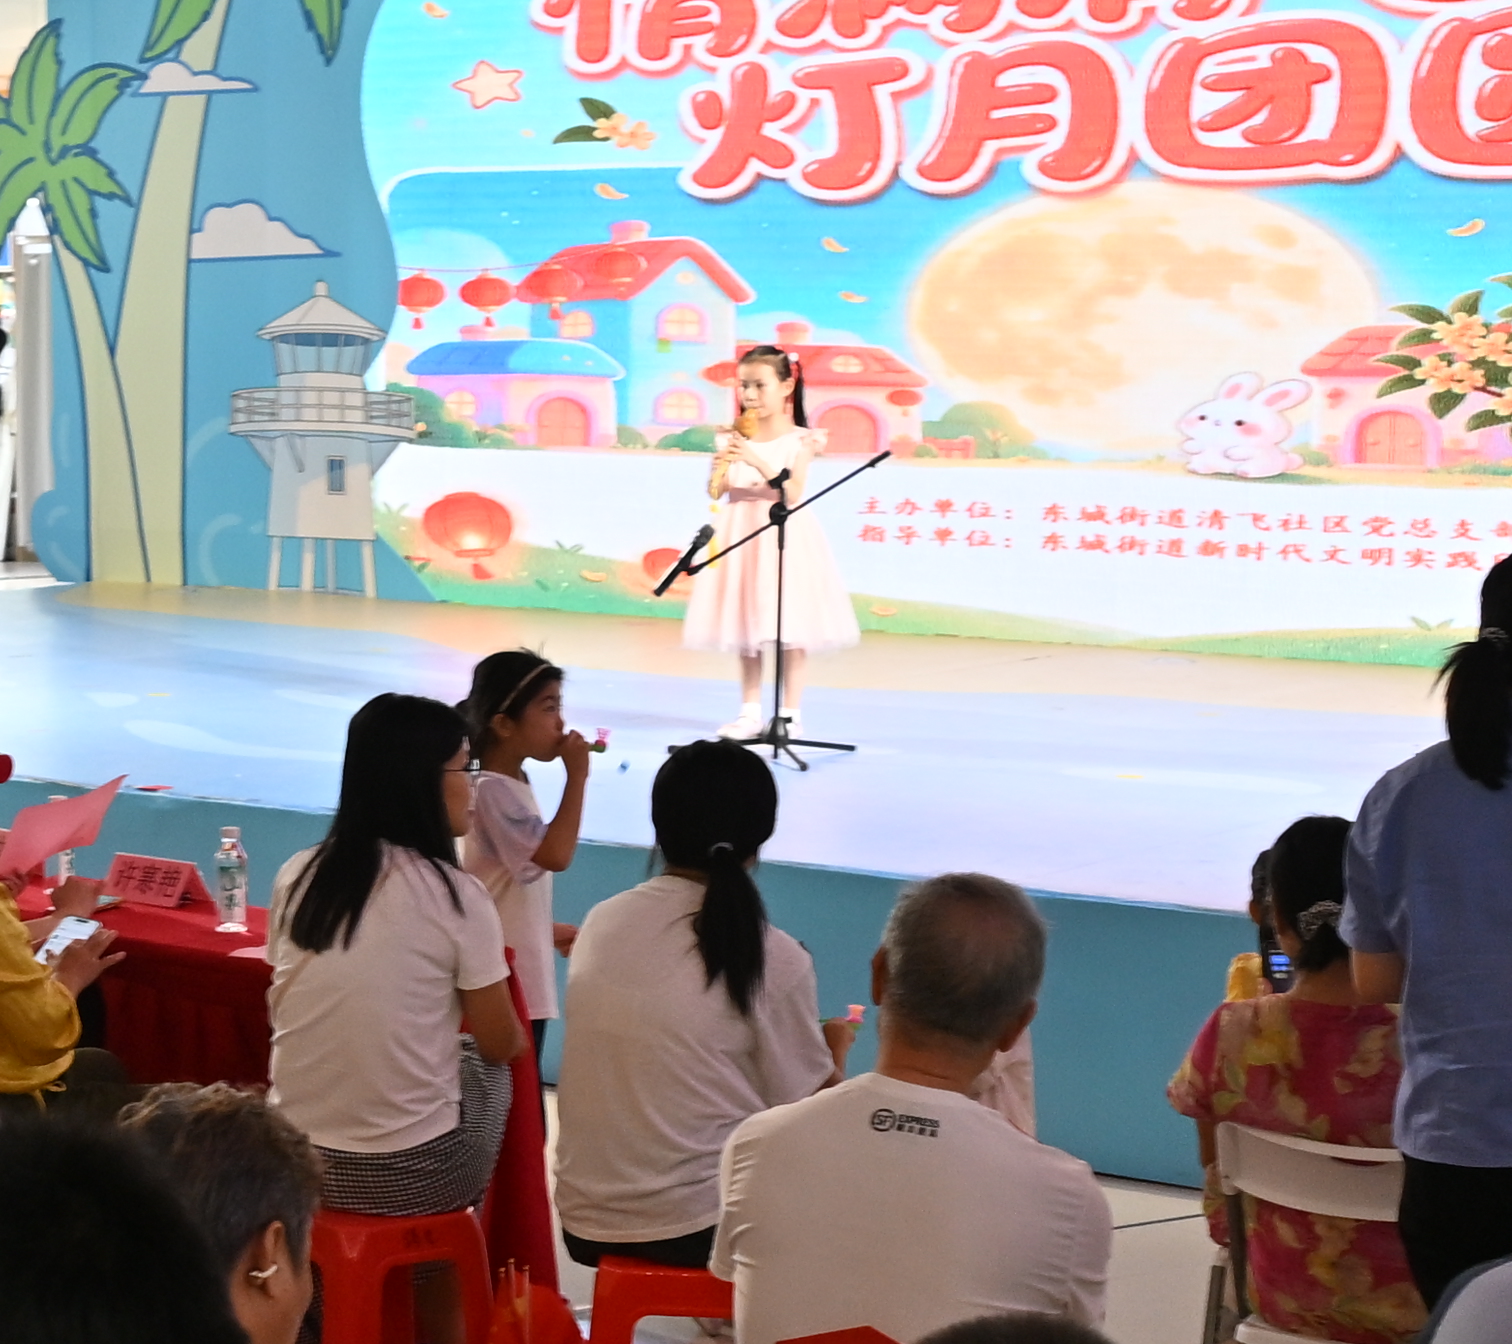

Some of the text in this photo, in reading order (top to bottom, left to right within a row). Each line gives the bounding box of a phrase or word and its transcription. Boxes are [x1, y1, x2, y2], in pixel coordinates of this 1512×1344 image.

[858, 496, 1013, 520] 主办单位：
[857, 524, 1510, 572] 指导单位： 东城街道新时代文明实践
